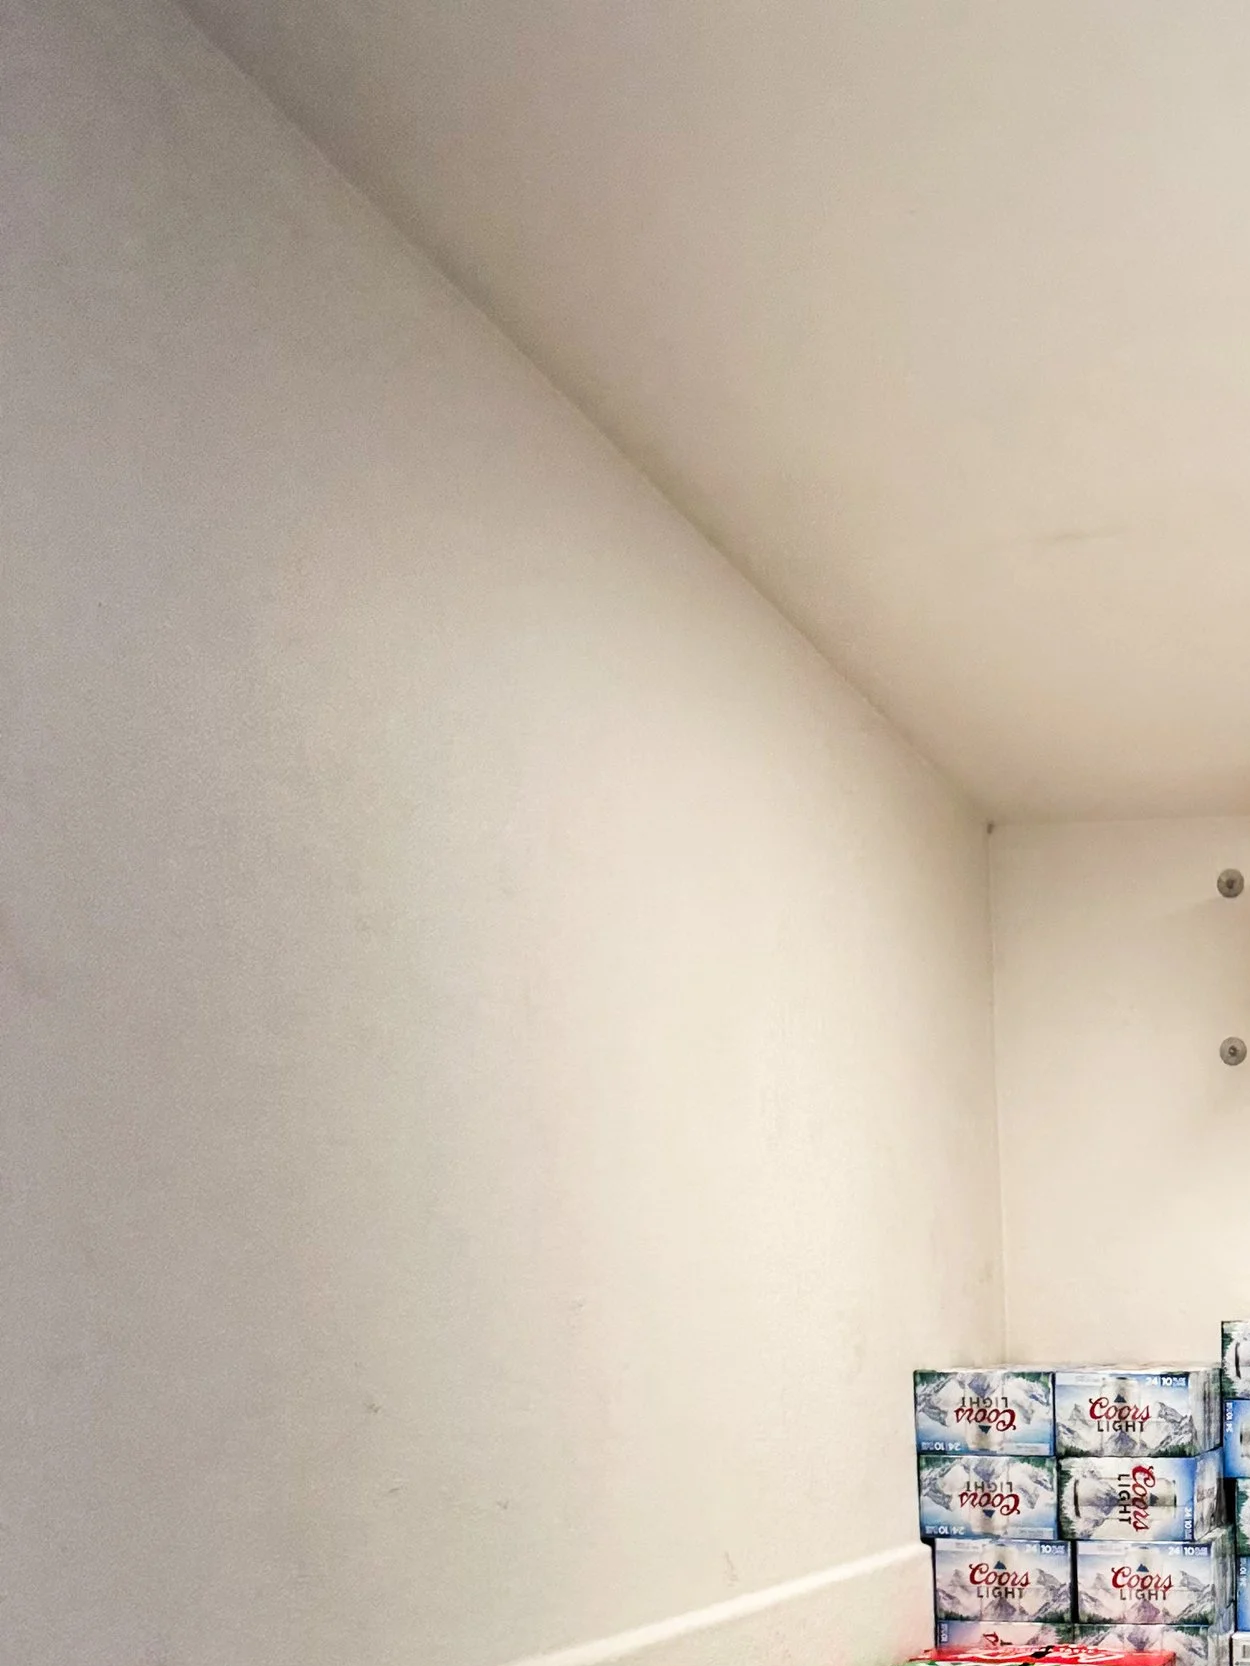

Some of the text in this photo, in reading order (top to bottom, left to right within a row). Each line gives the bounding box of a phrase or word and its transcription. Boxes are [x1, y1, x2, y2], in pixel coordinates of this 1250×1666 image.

[962, 1397, 1008, 1408] LIGHT
[1089, 1397, 1150, 1421] Coors
[954, 1407, 1016, 1431] Coors
[1097, 1422, 1145, 1432] LIGHT
[965, 1481, 1013, 1492] LIGHT
[959, 1491, 1021, 1516] Coors
[1118, 1474, 1131, 1525] LIGHT
[1132, 1465, 1156, 1533] Coors
[969, 1563, 1030, 1587] Coors
[1111, 1566, 1174, 1591] Coors
[977, 1587, 1025, 1599] LIGHT
[1120, 1589, 1168, 1600] LIGHT
